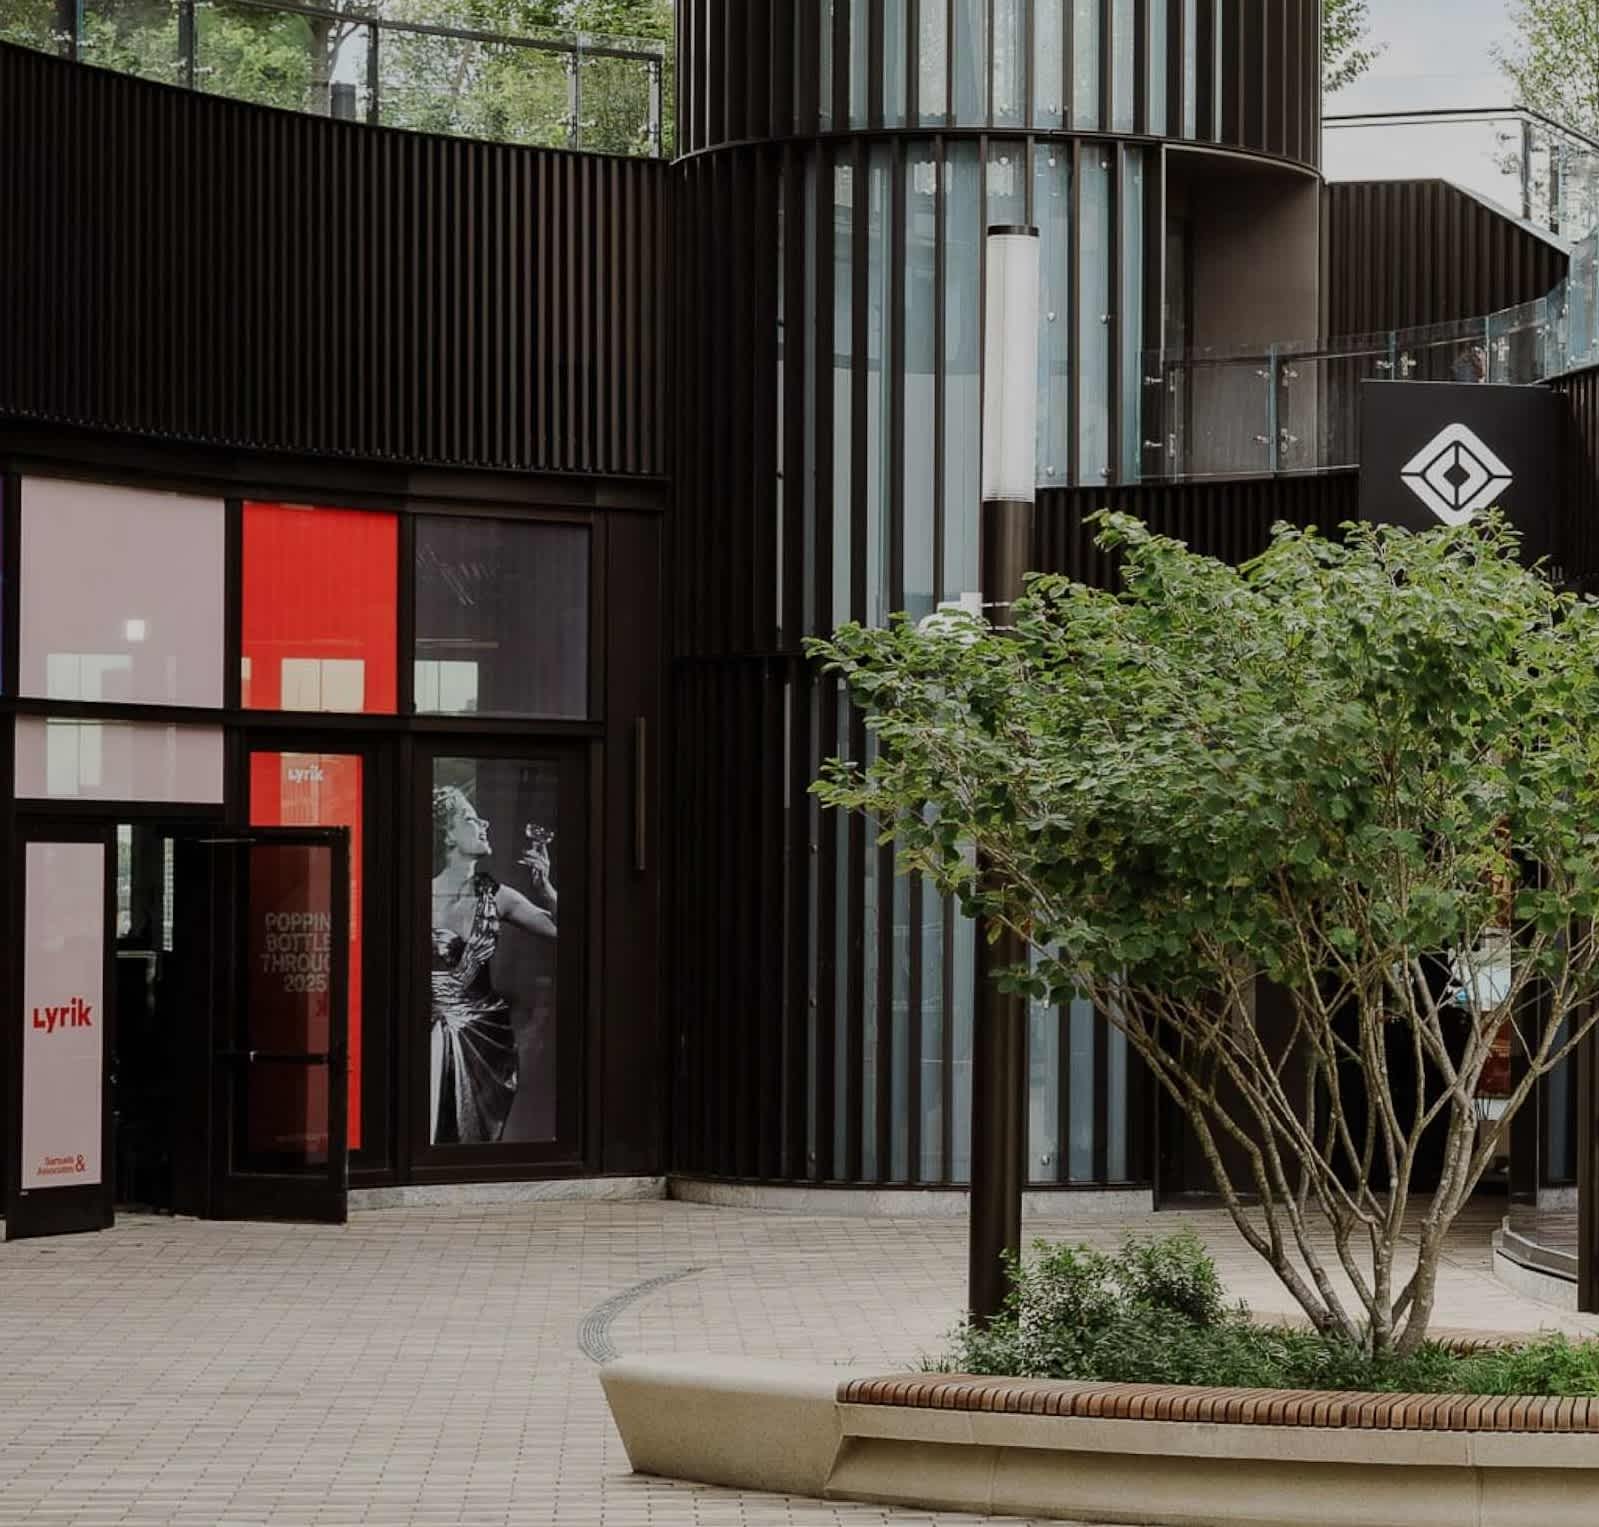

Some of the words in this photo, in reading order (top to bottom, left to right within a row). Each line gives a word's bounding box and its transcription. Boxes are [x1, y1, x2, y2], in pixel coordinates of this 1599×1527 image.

[288, 763, 324, 784] Lyrik
[284, 974, 328, 992] 2025
[33, 997, 92, 1033] Lyrik
